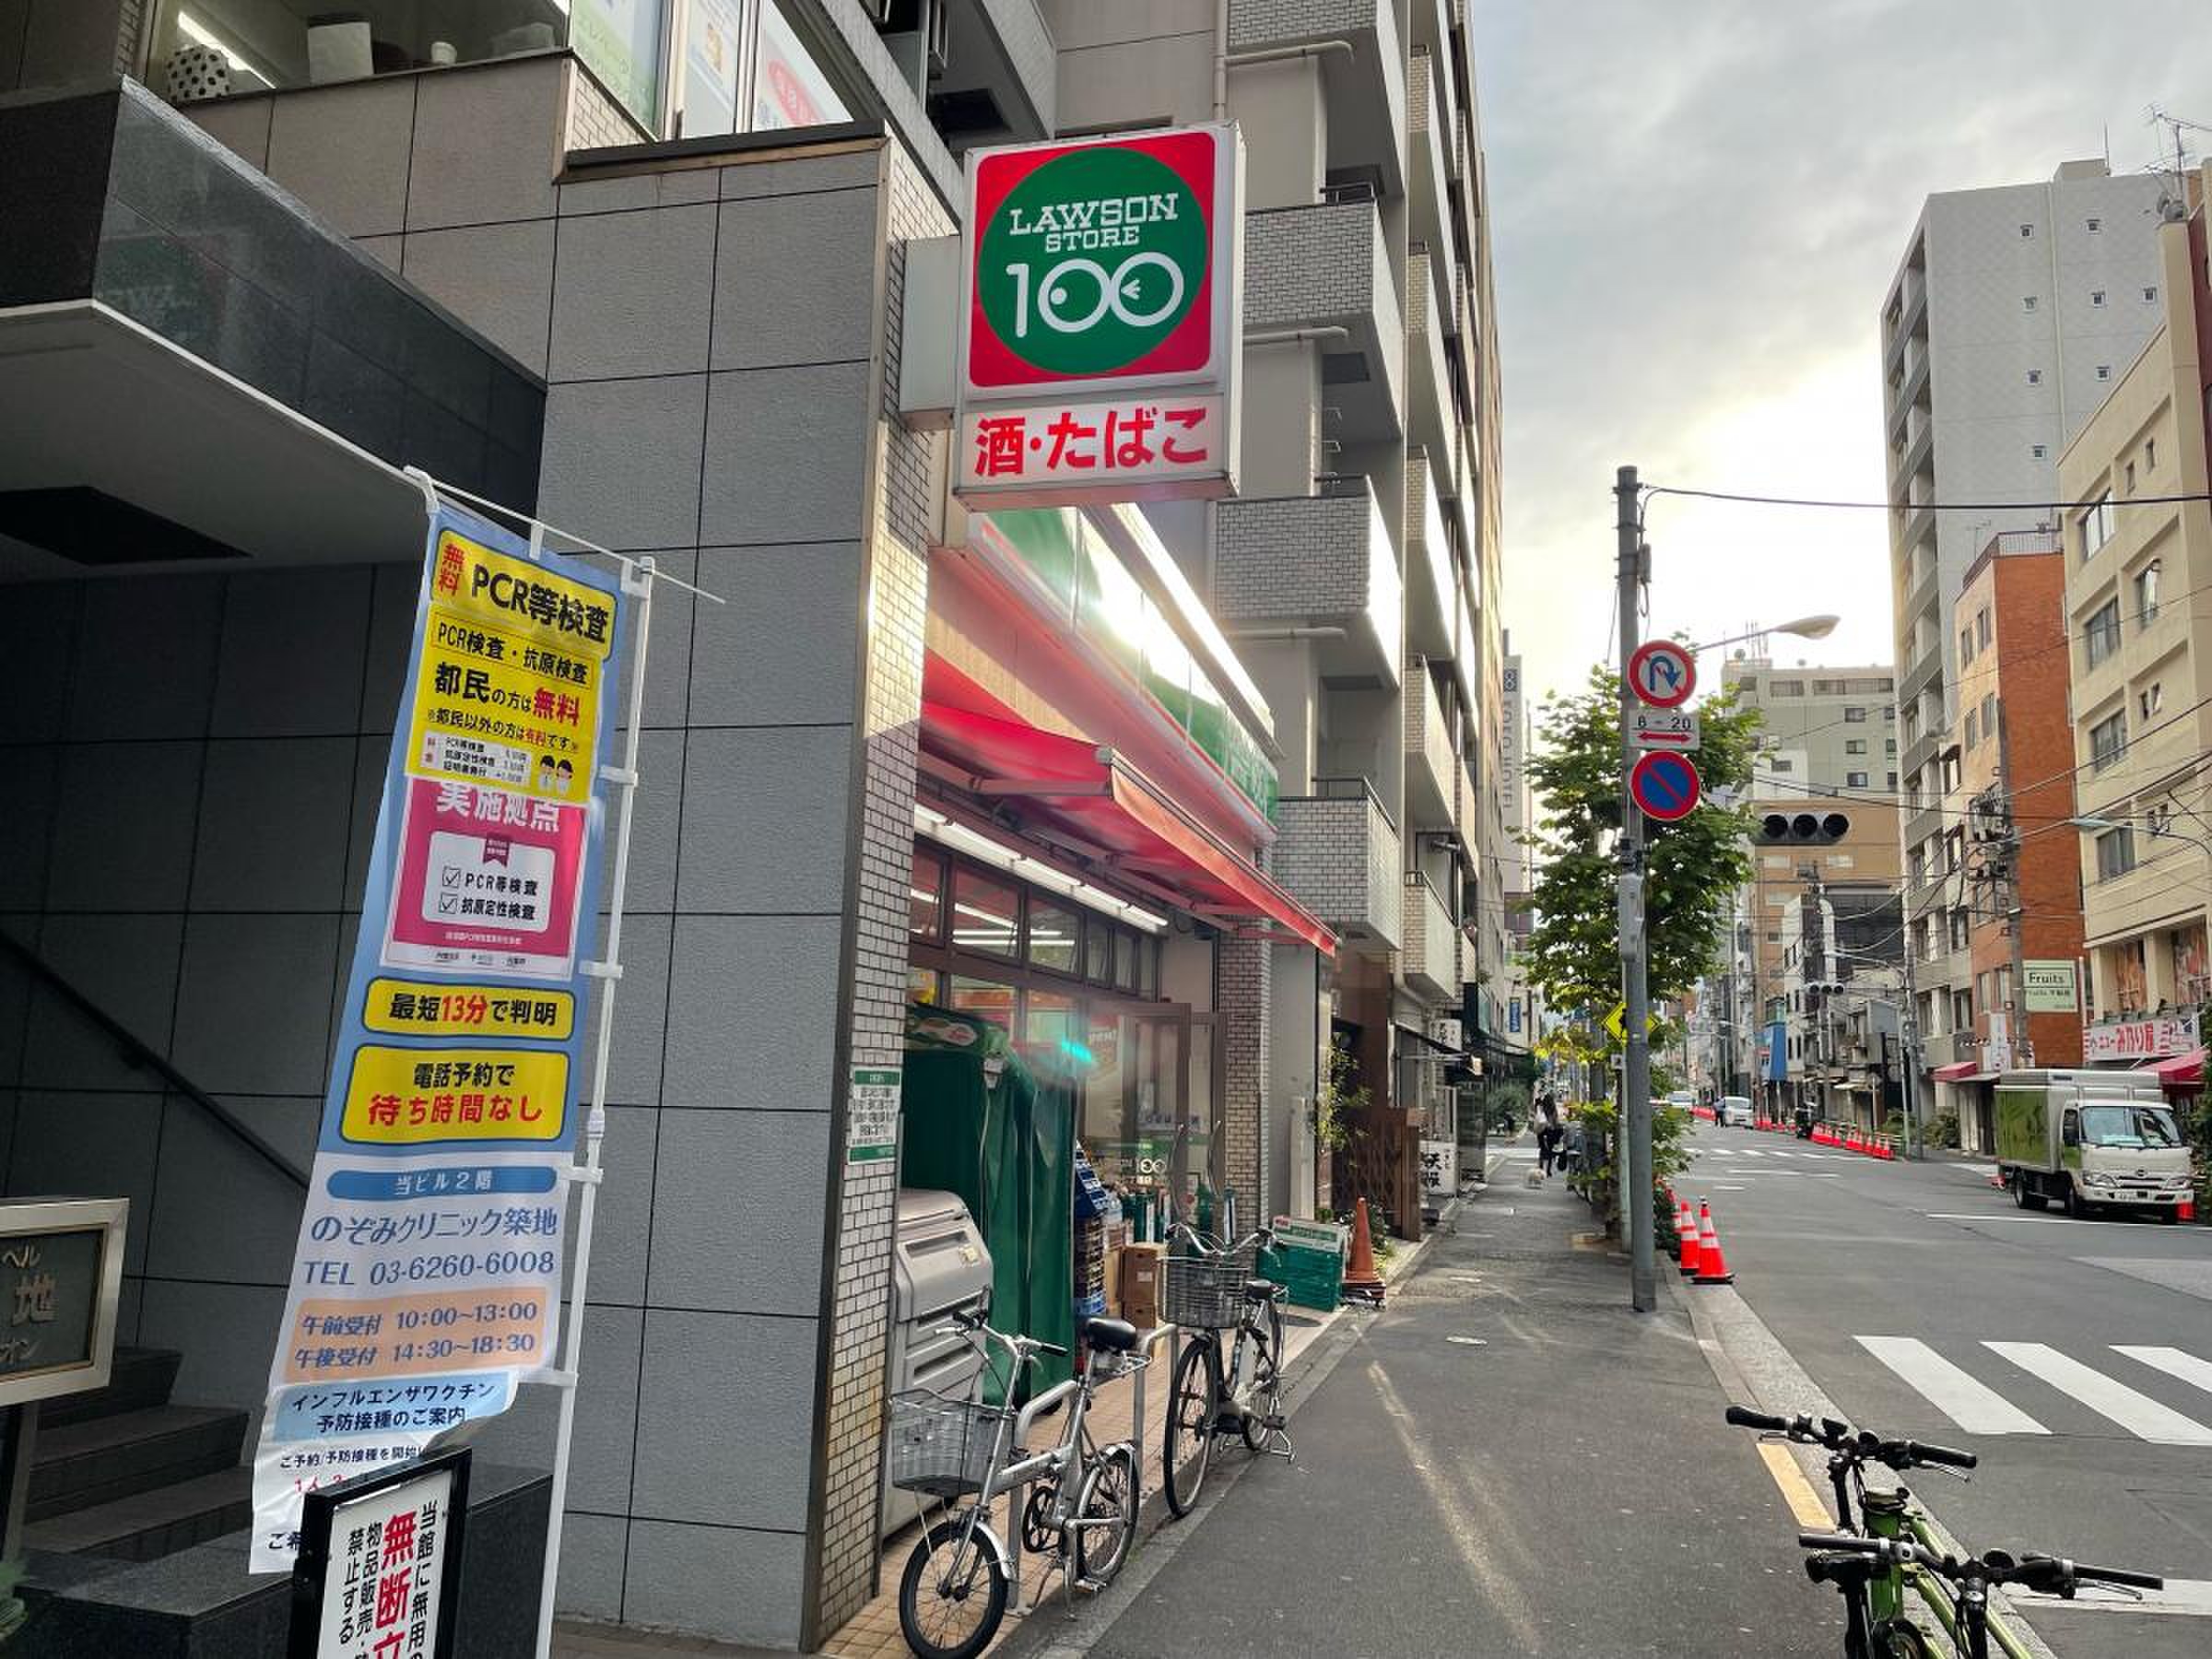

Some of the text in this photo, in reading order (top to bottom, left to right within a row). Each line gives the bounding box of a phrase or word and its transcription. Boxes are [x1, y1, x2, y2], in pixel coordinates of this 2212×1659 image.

[1009, 192, 1179, 236] LAWSON
[1045, 225, 1139, 253] STORE
[1006, 252, 1184, 338] 100
[974, 406, 1207, 477] 酒・たばこ
[471, 563, 609, 644] PCR等検査
[438, 621, 589, 685] PCR検査・抗原検査
[434, 661, 580, 726] 都民の方は無料
[465, 873, 538, 896] PCR等検査
[389, 994, 558, 1027] 最短13分で判明
[414, 1063, 516, 1089] 電話予約で
[369, 1094, 543, 1127] 待ち時間なし
[311, 1206, 558, 1246] のぞみクリニック築地
[303, 1251, 555, 1286] TEL 03-6260-6008
[301, 1313, 383, 1336] 午前受付
[295, 1346, 378, 1369] 午後受付
[292, 1382, 495, 1411] インフルエンザワクチン
[316, 1406, 465, 1433] 予防接種のご案内
[338, 1527, 366, 1645] 禁止する
